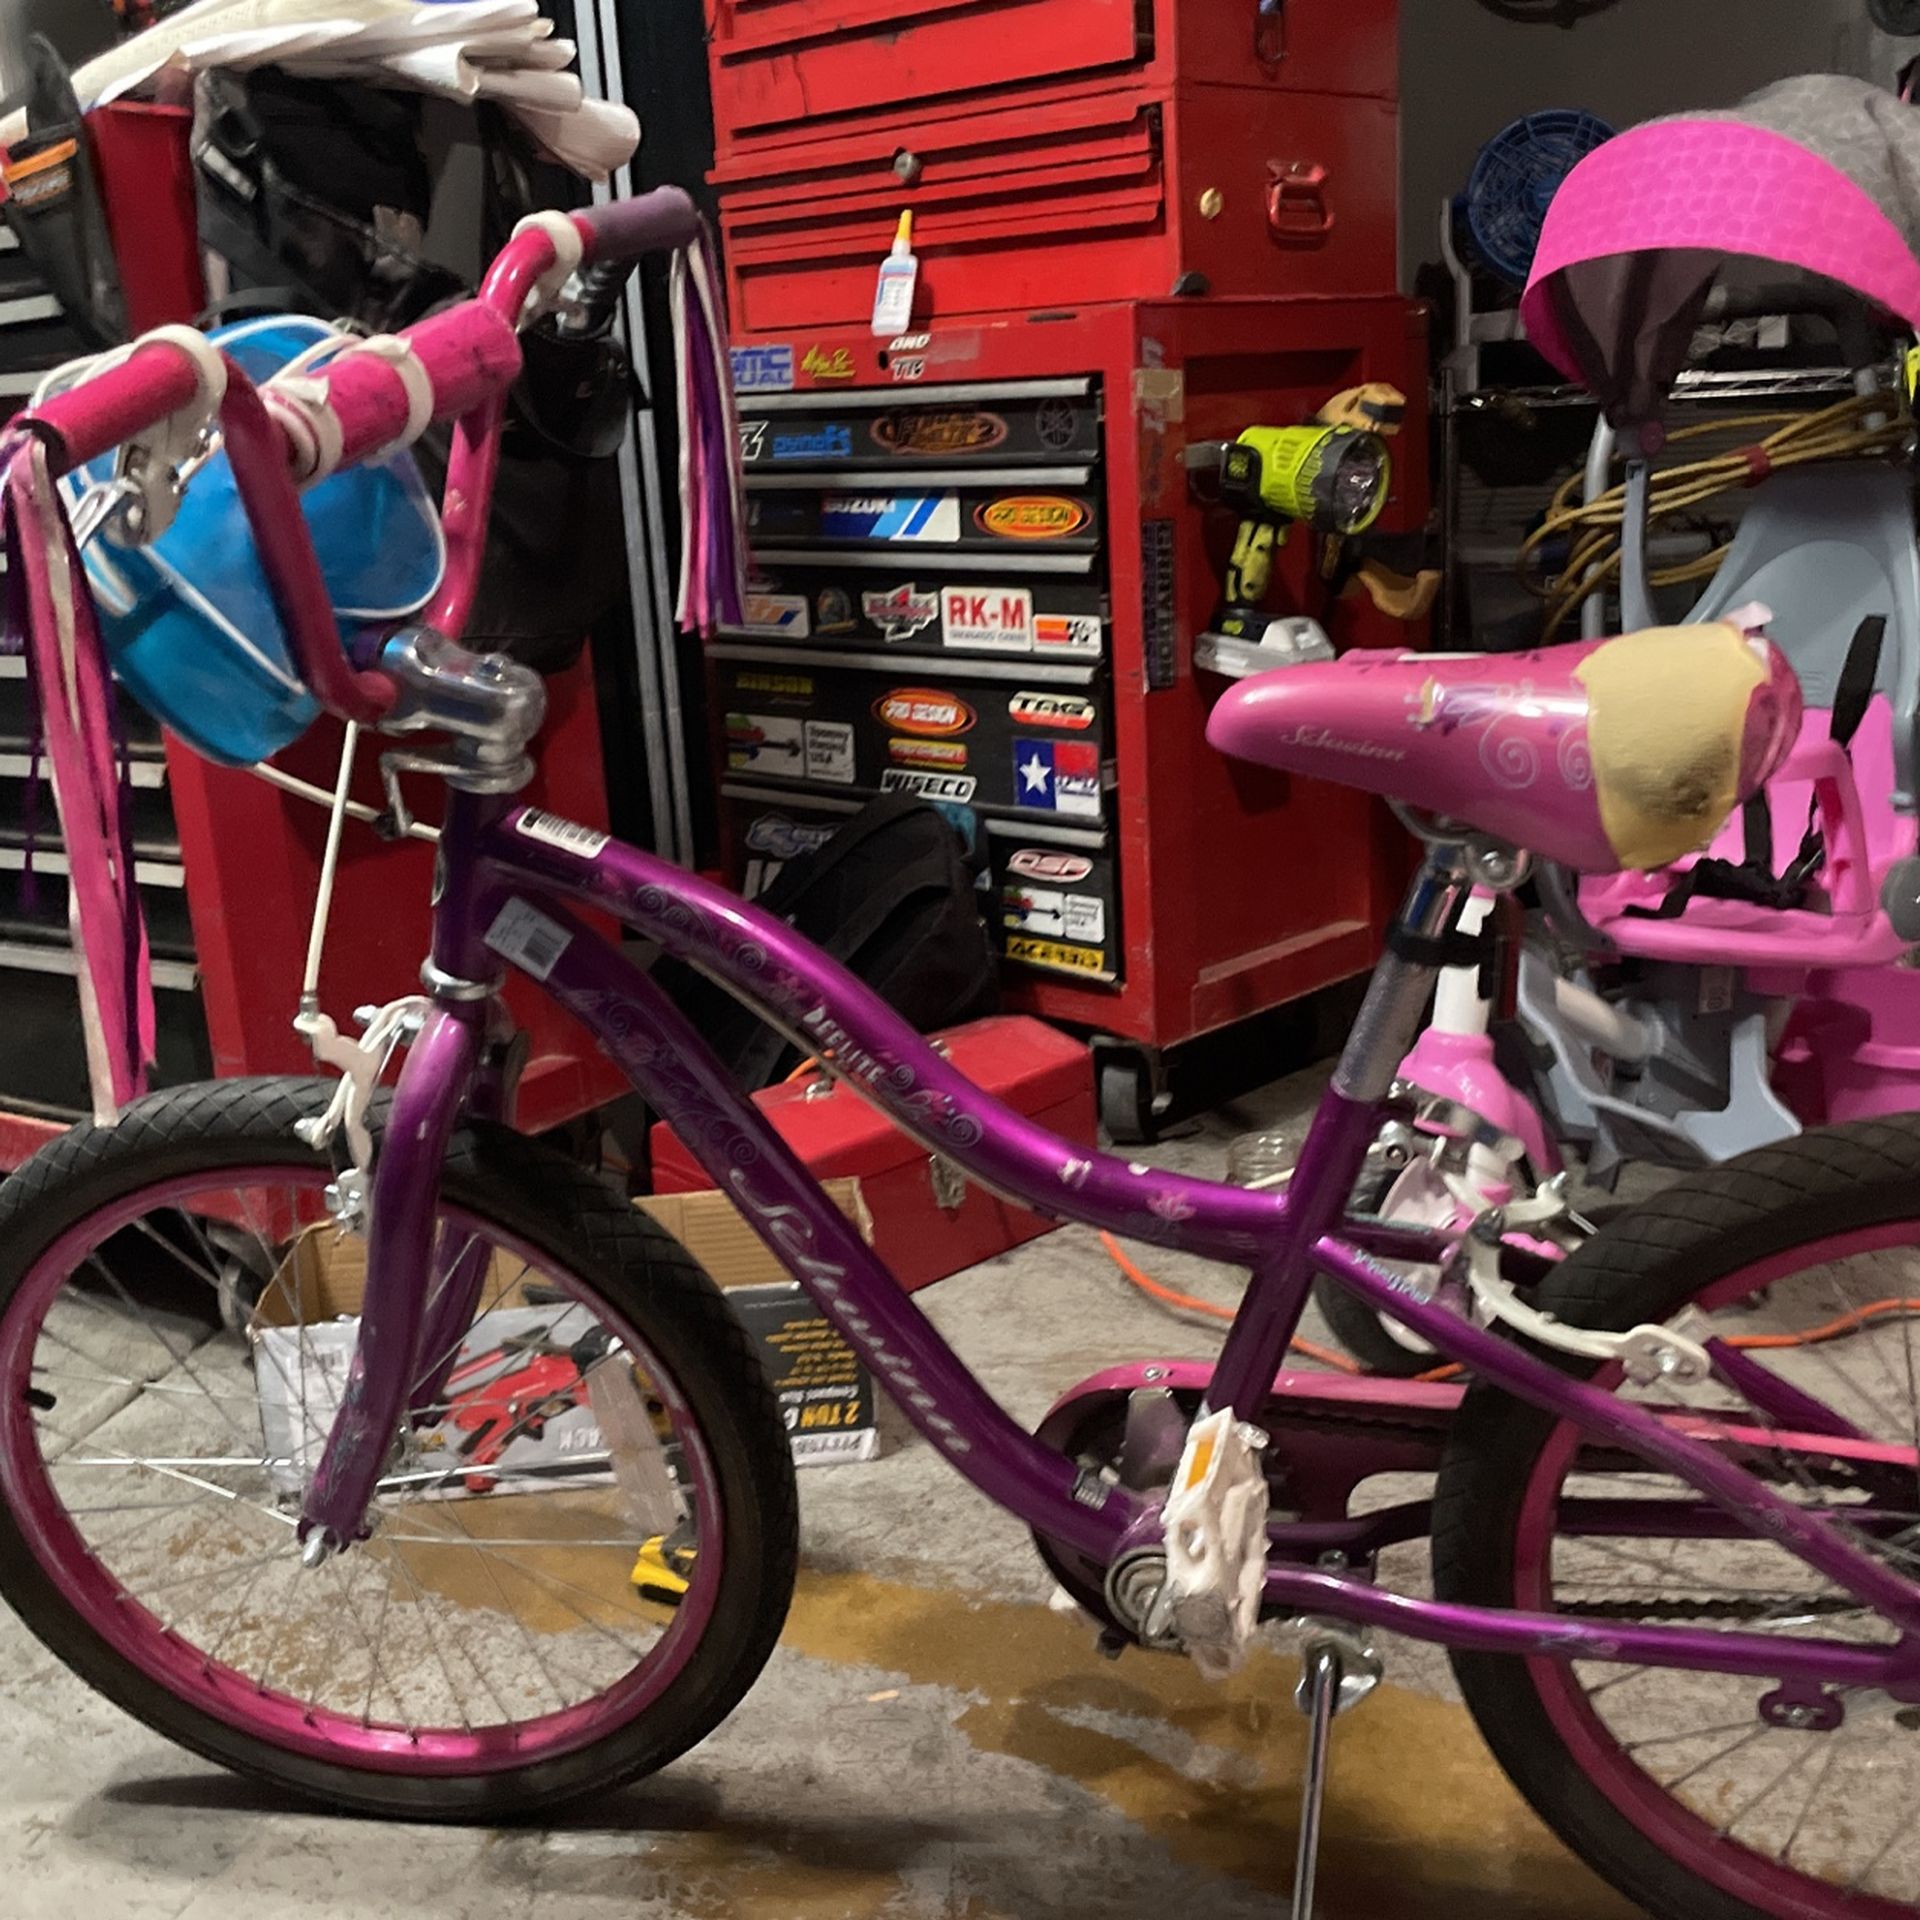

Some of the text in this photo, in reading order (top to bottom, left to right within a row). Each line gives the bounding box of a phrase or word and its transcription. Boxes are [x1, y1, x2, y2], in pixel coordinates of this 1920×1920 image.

[948, 595, 1025, 629] RK-M
[1281, 725, 1406, 763] Schwinn
[884, 770, 972, 797] WISECO
[730, 1168, 971, 1452] Schwinn
